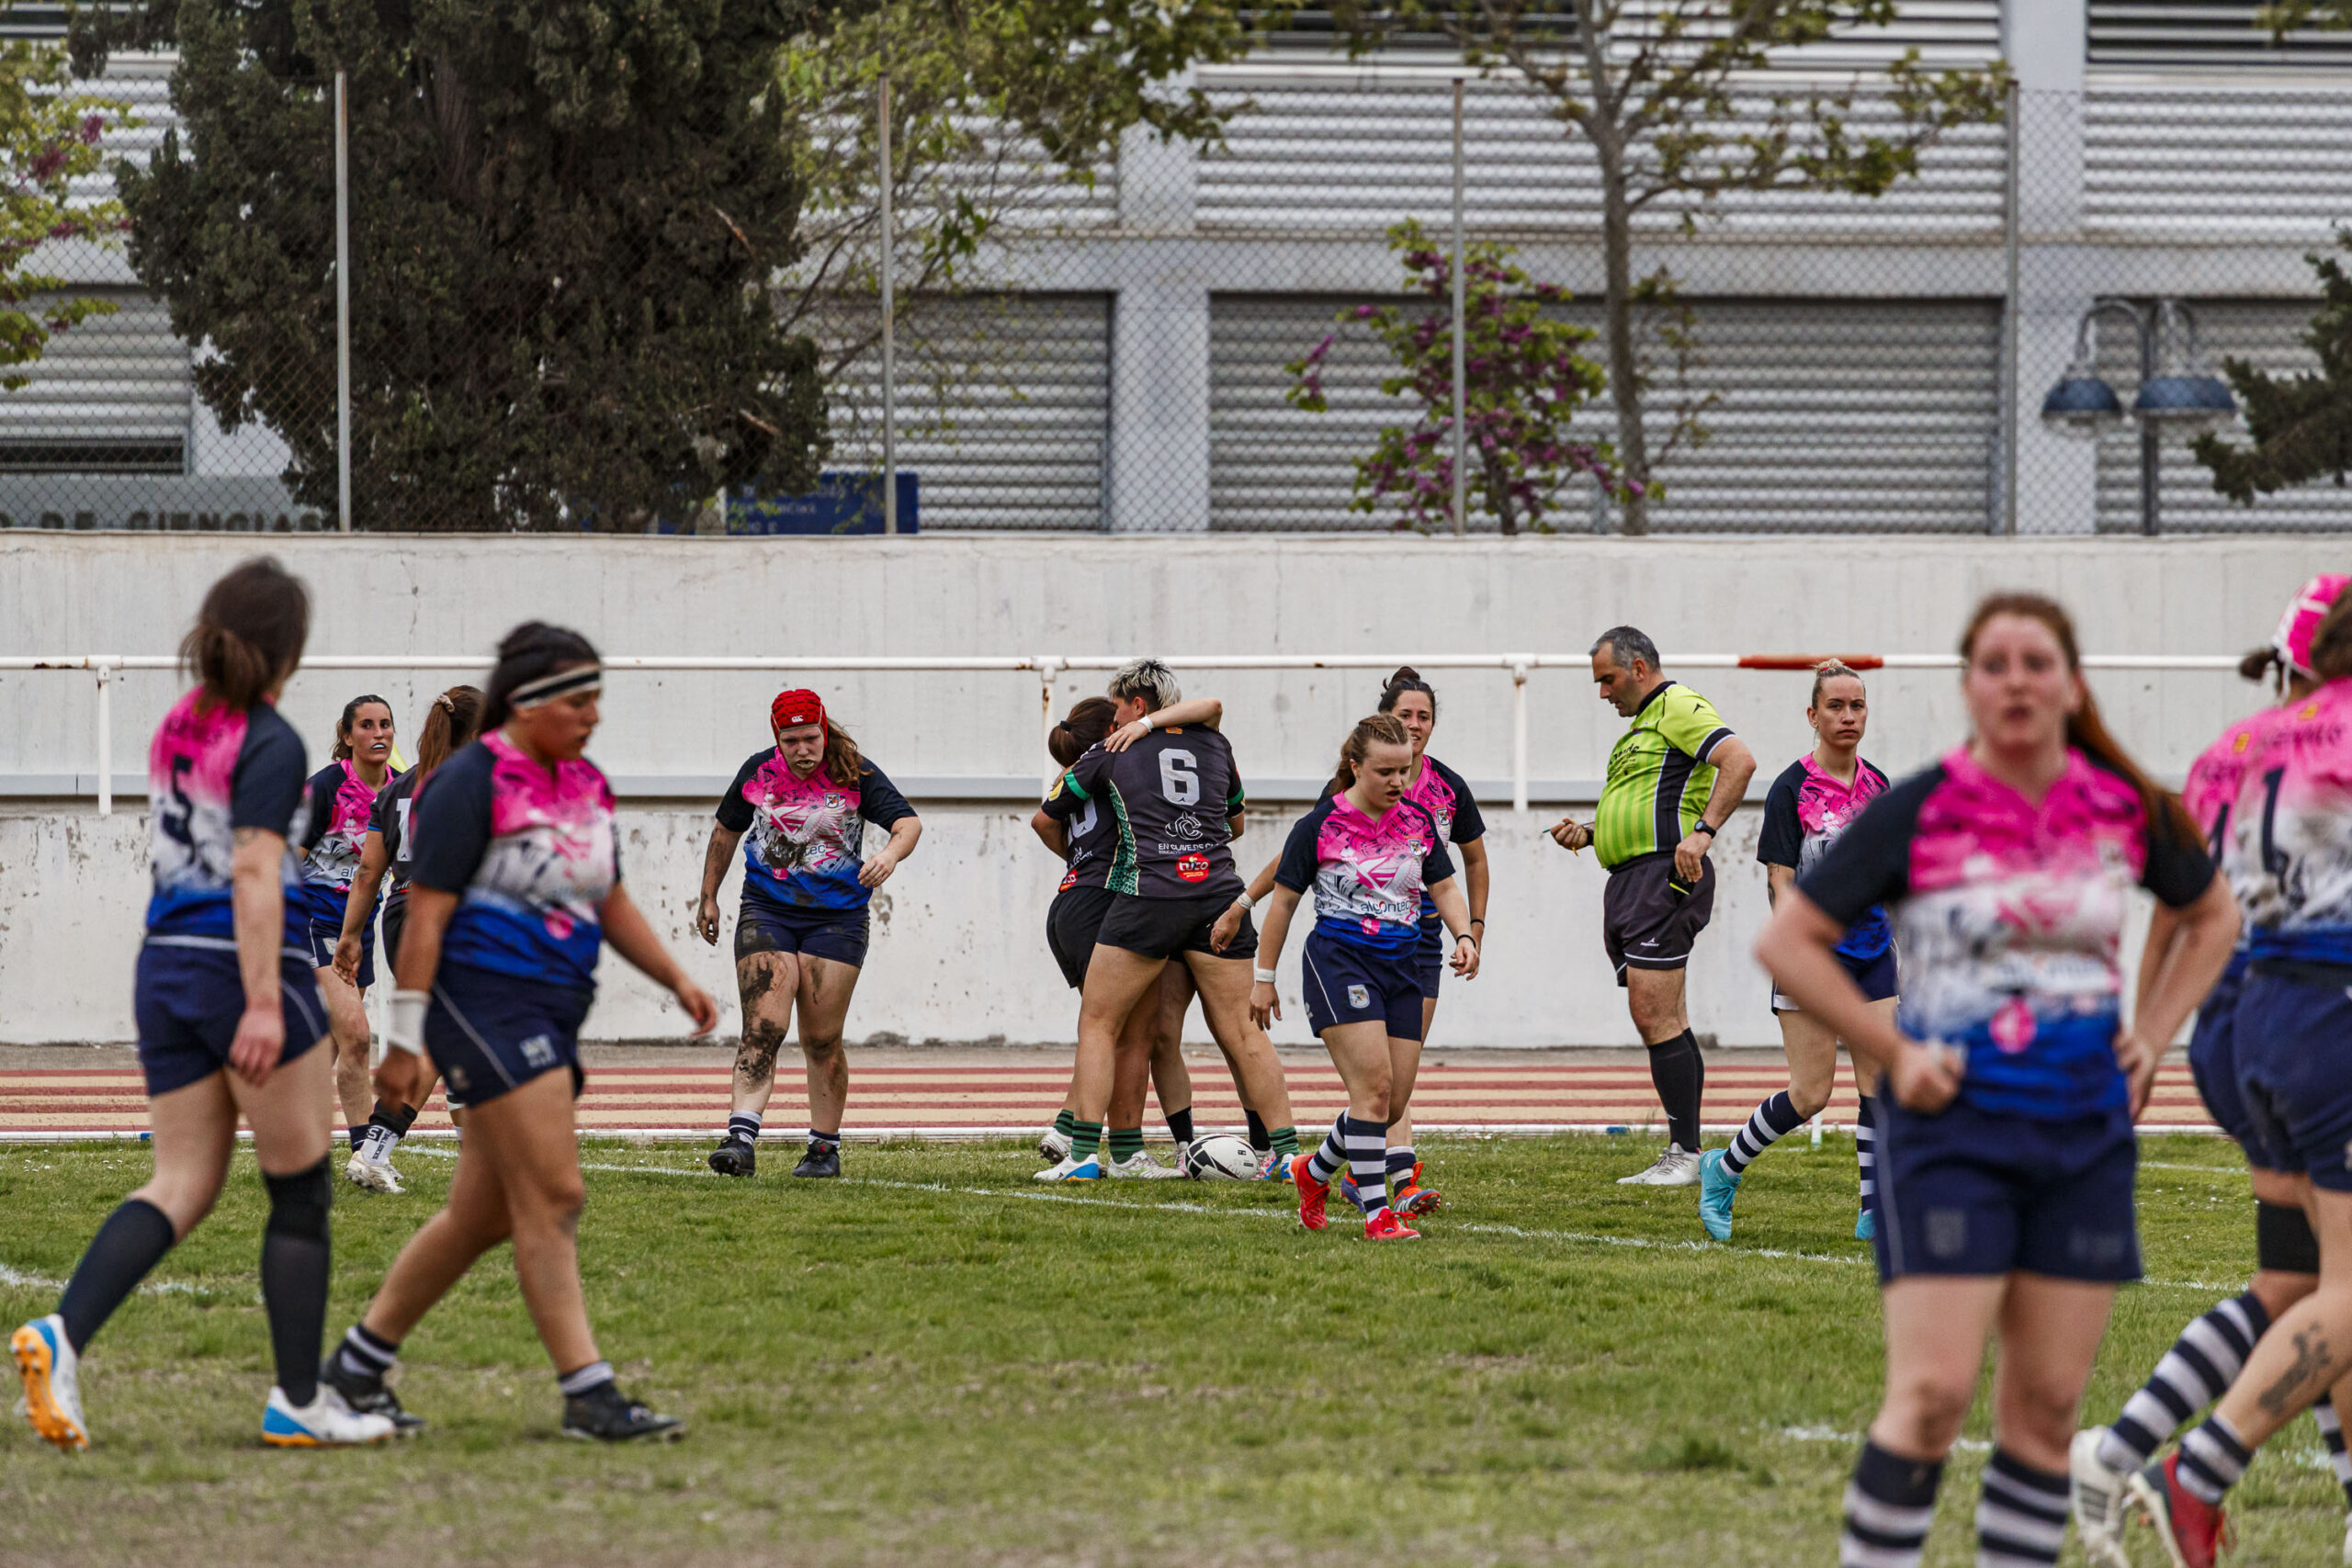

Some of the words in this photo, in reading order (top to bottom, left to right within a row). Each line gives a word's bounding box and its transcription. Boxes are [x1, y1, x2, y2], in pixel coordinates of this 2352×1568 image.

[162, 754, 194, 845] 5
[1159, 748, 1200, 806] 6
[1360, 899, 1410, 915] algontec
